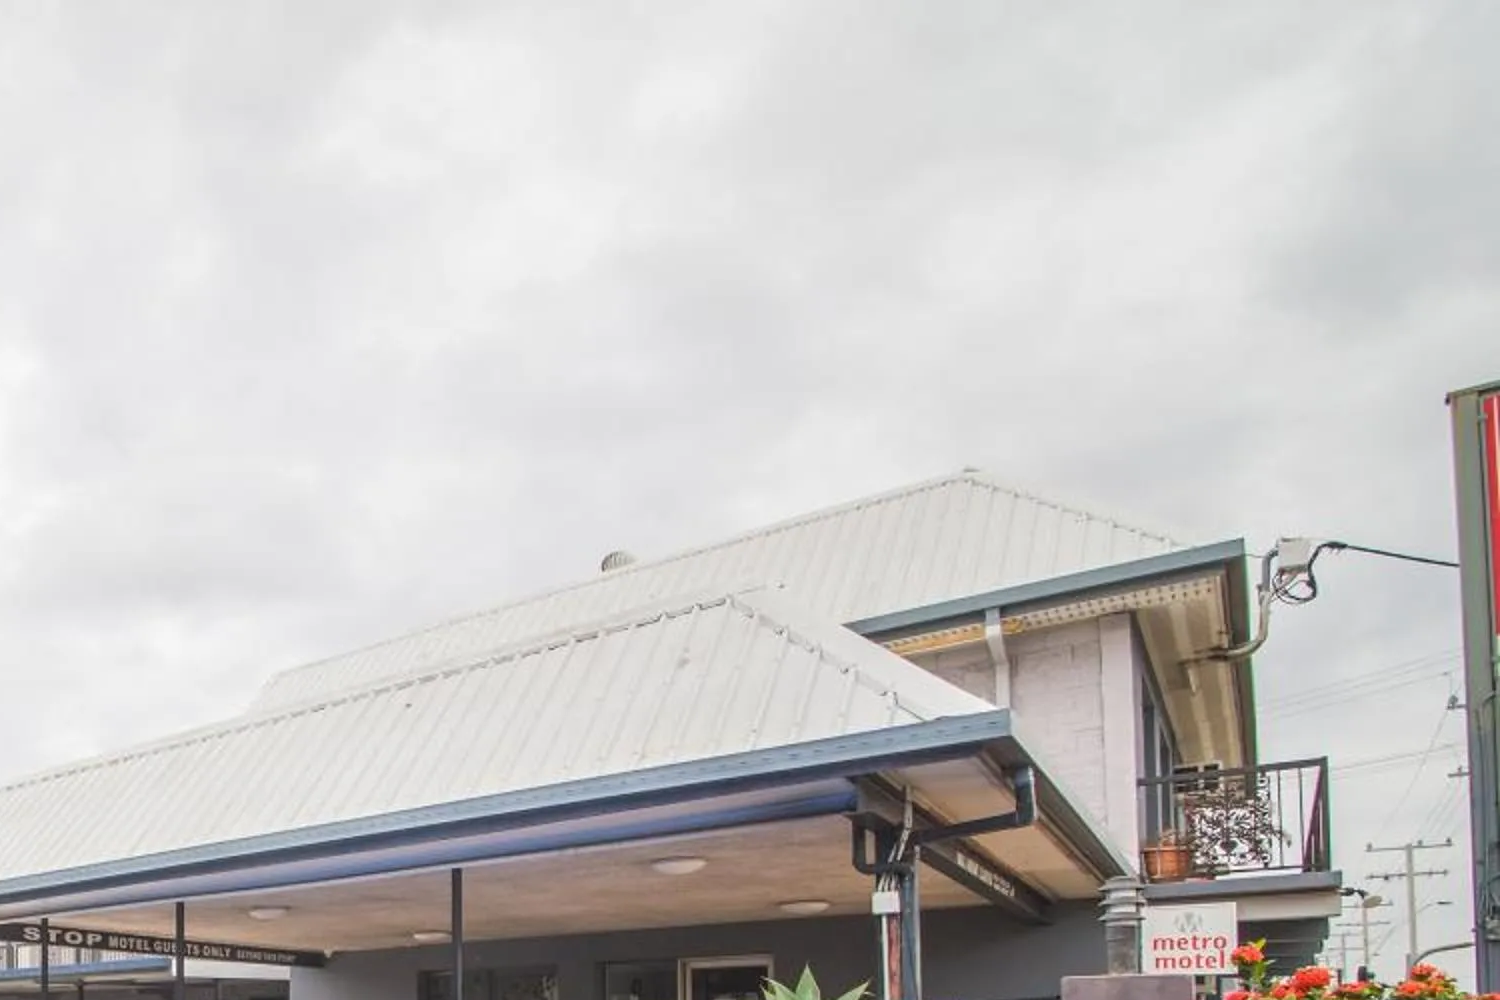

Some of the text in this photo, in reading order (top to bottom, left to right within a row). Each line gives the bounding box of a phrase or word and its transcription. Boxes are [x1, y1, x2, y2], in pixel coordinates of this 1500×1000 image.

[22, 926, 103, 947] STOP
[107, 935, 151, 951] MOTEL
[153, 941, 199, 956] GUETS
[203, 945, 231, 957] ONLY
[1153, 934, 1227, 951] metro
[1155, 950, 1225, 969] motel
